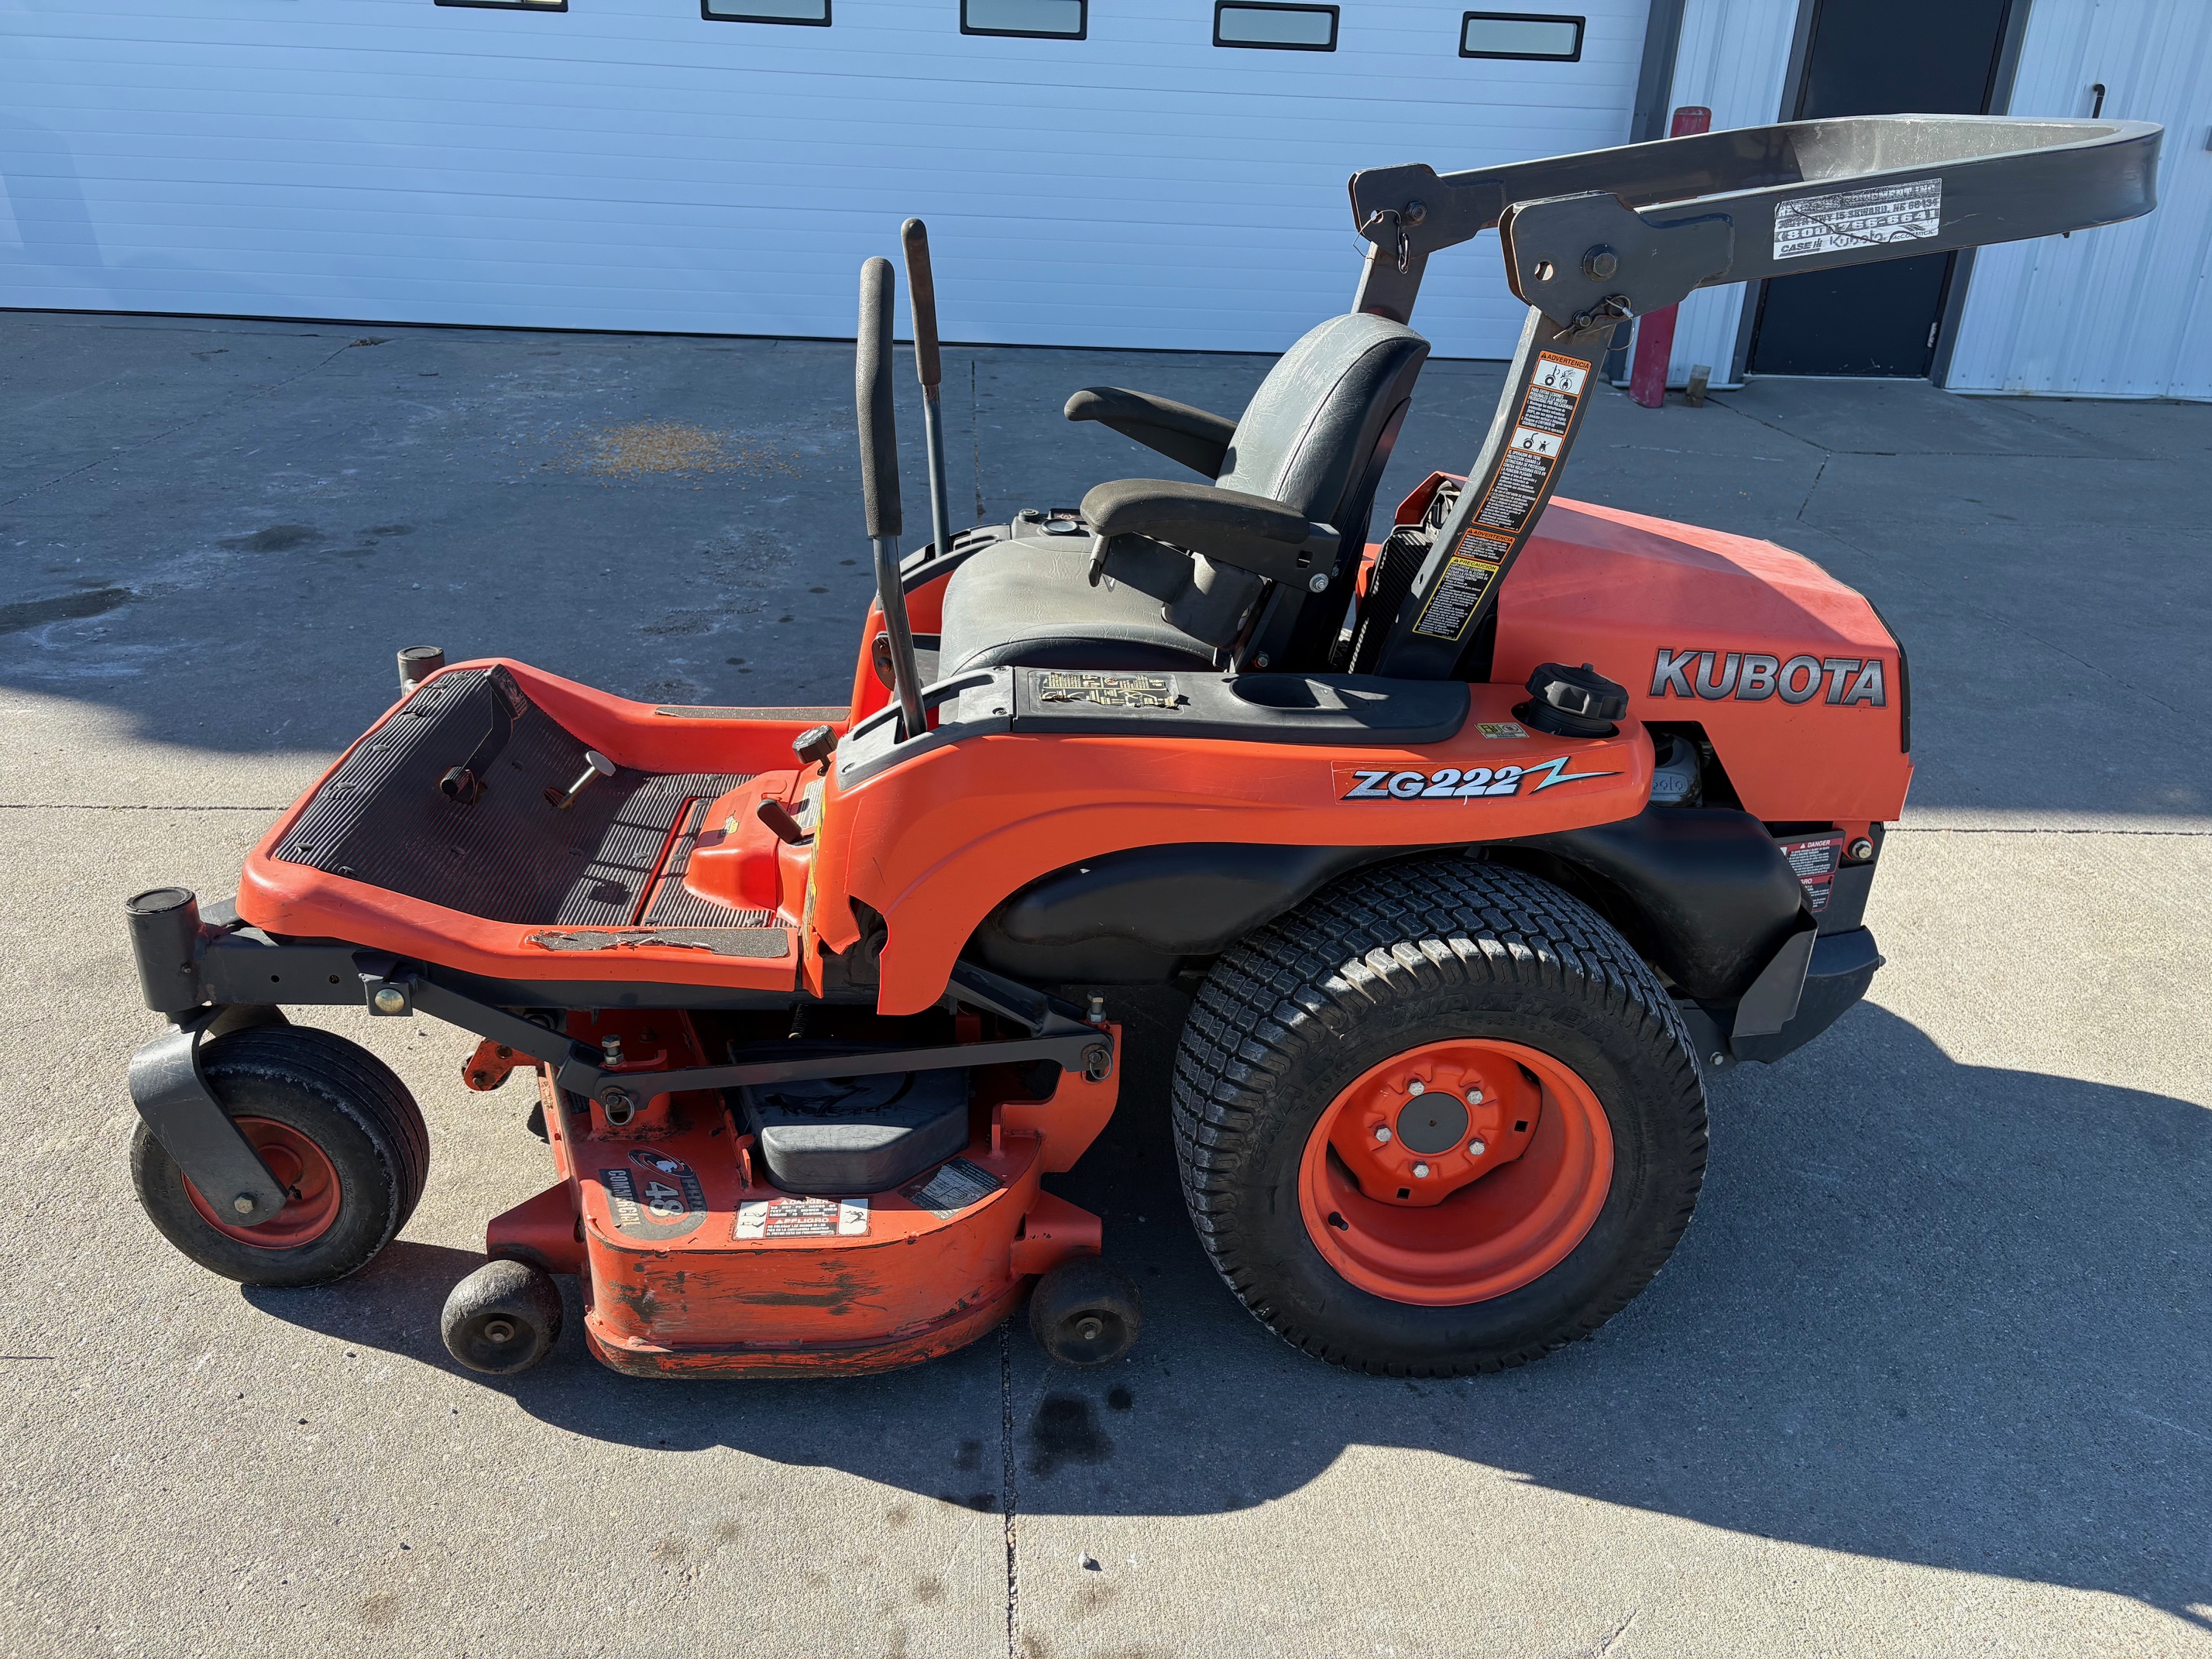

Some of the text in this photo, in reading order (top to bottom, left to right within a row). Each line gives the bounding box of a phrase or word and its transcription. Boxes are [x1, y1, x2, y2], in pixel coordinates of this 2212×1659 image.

[1781, 241, 1813, 252] CASE
[1547, 353, 1589, 369] ADVERTENCIA
[1473, 531, 1513, 542] ADVERTENCIA
[1650, 648, 1887, 707] KUBOTA
[1340, 765, 1524, 800] ZG222
[1807, 840, 1831, 848] DANGER
[608, 1170, 641, 1227] COMMERCIAL
[644, 1181, 685, 1217] 48
